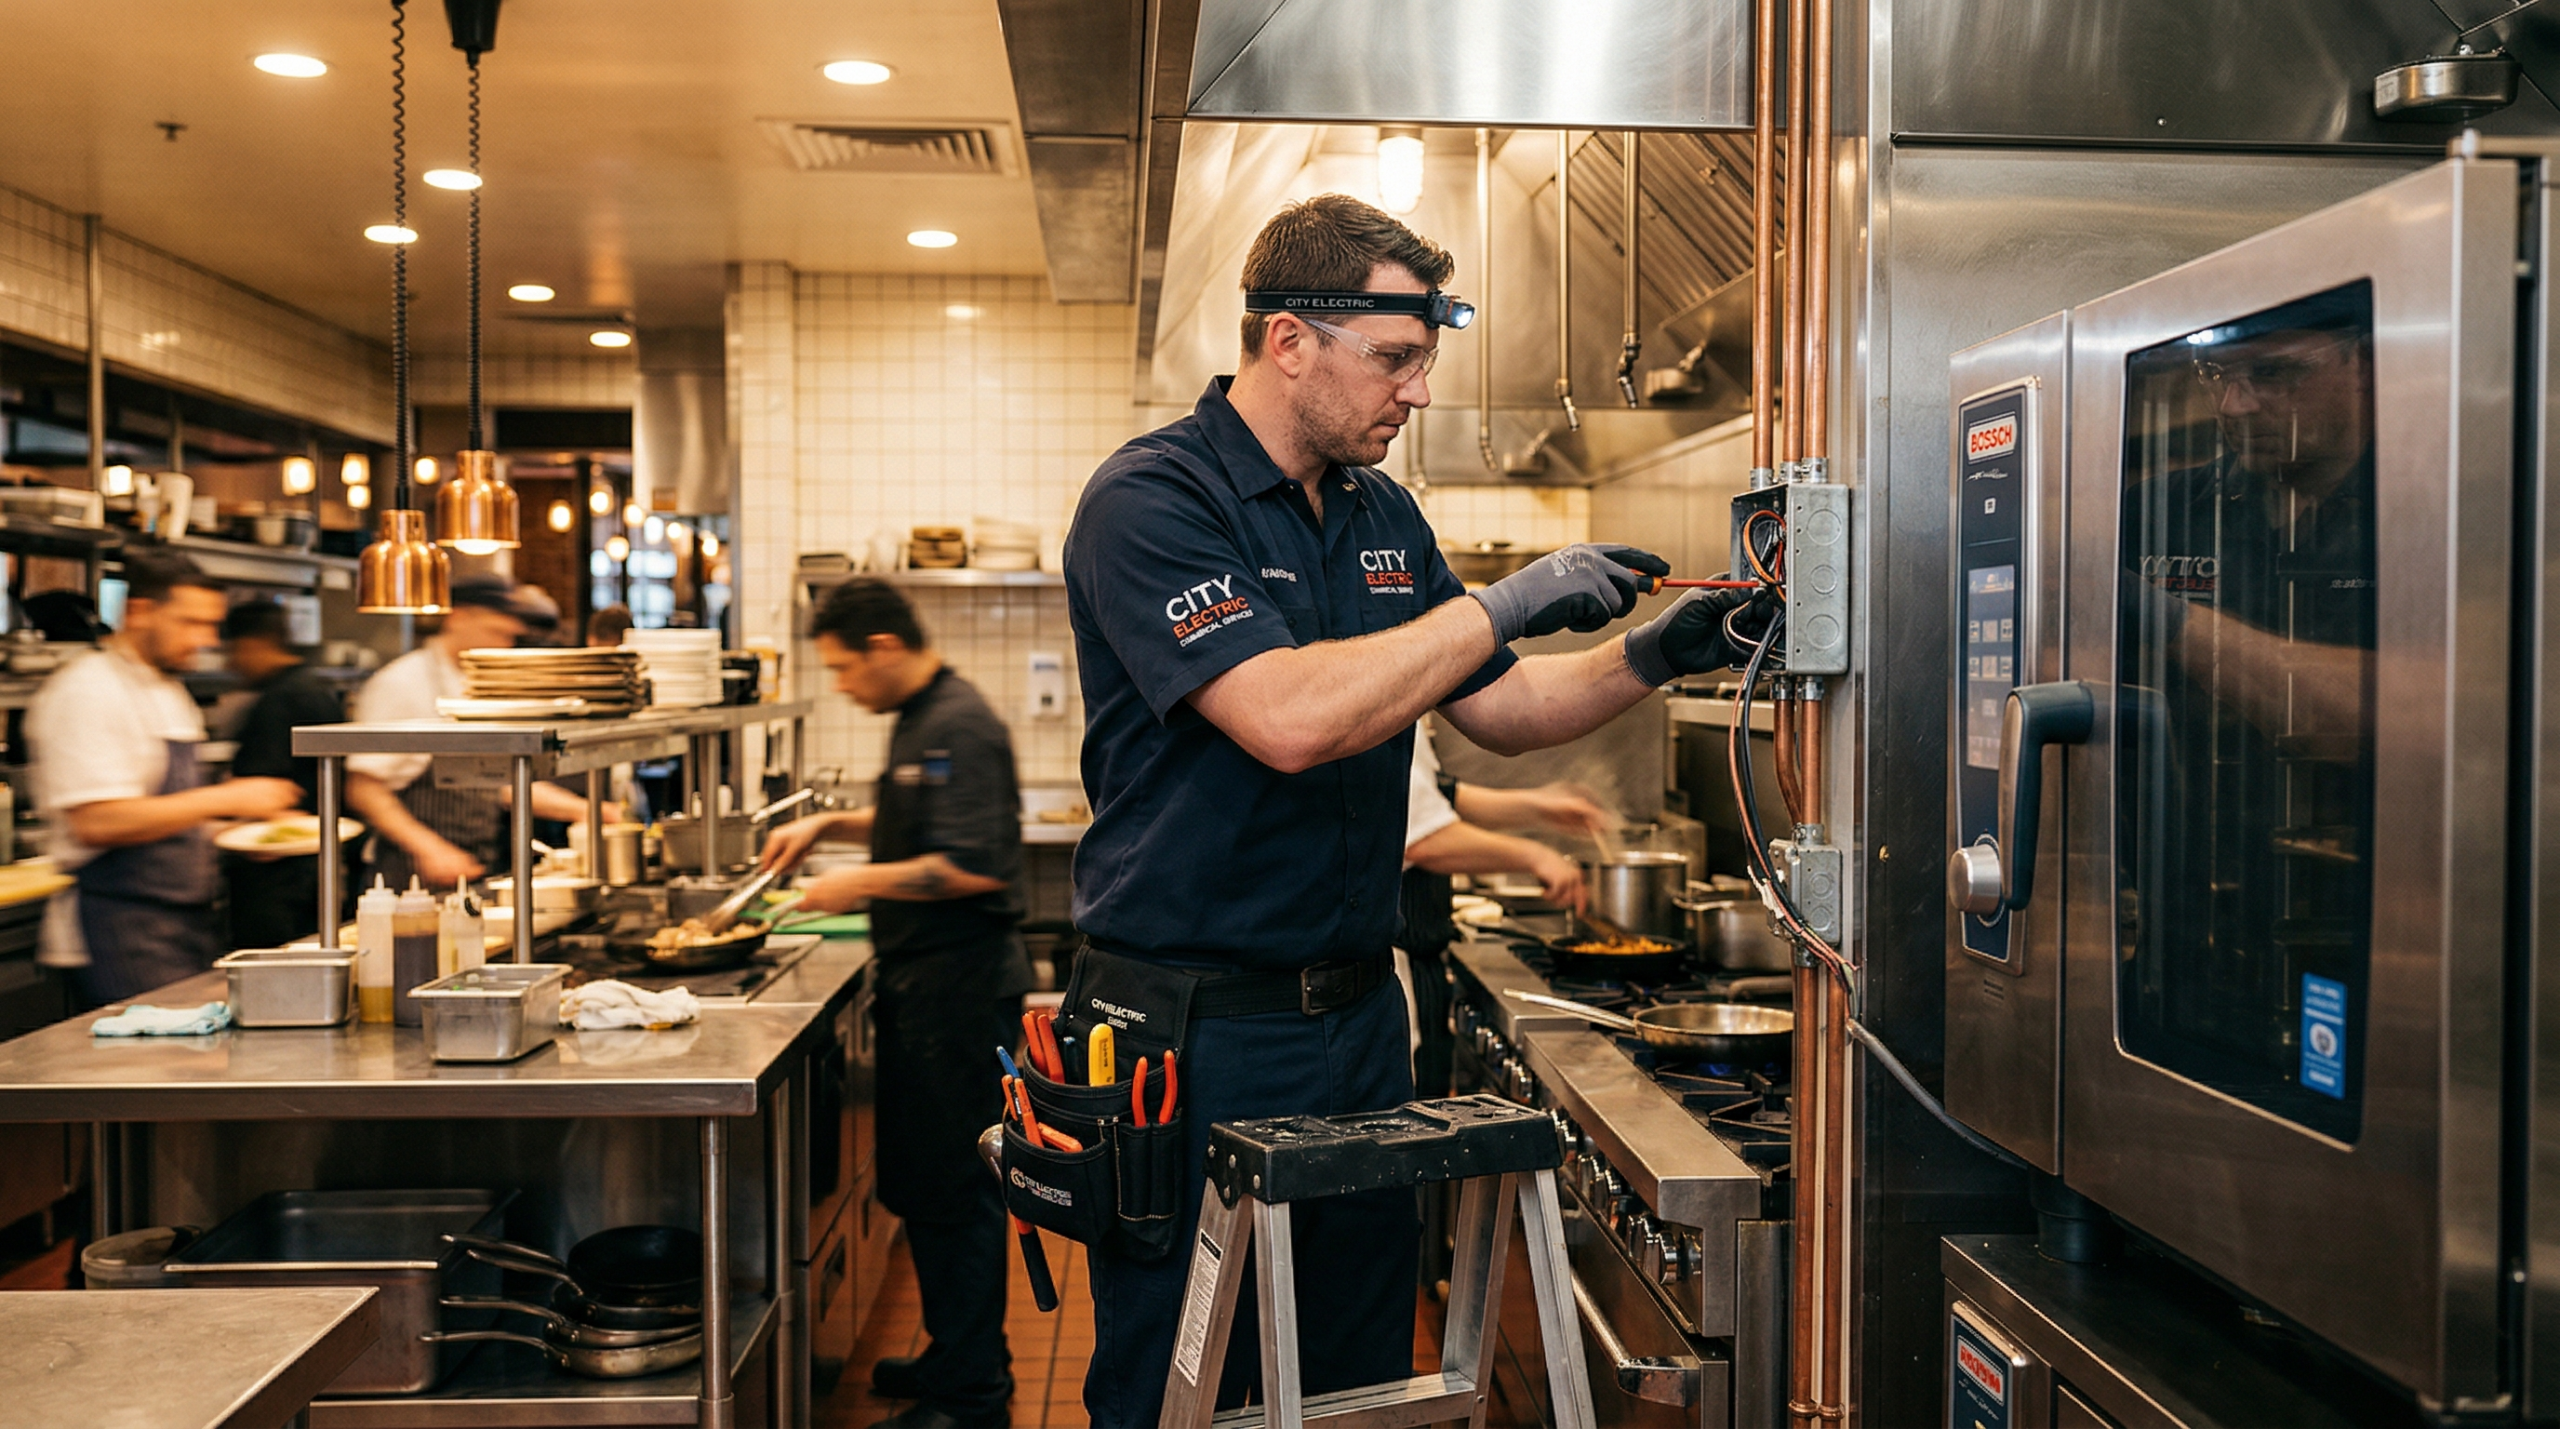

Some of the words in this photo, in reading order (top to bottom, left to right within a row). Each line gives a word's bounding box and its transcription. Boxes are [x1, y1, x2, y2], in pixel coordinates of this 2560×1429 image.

[1285, 298, 1309, 307] CITY
[1312, 298, 1375, 308] ELECTRIC
[1971, 424, 2013, 453] BOSSCH
[1360, 549, 1406, 571] CITY
[1166, 574, 1233, 622] CITY
[1173, 596, 1249, 639] ELECTRIC
